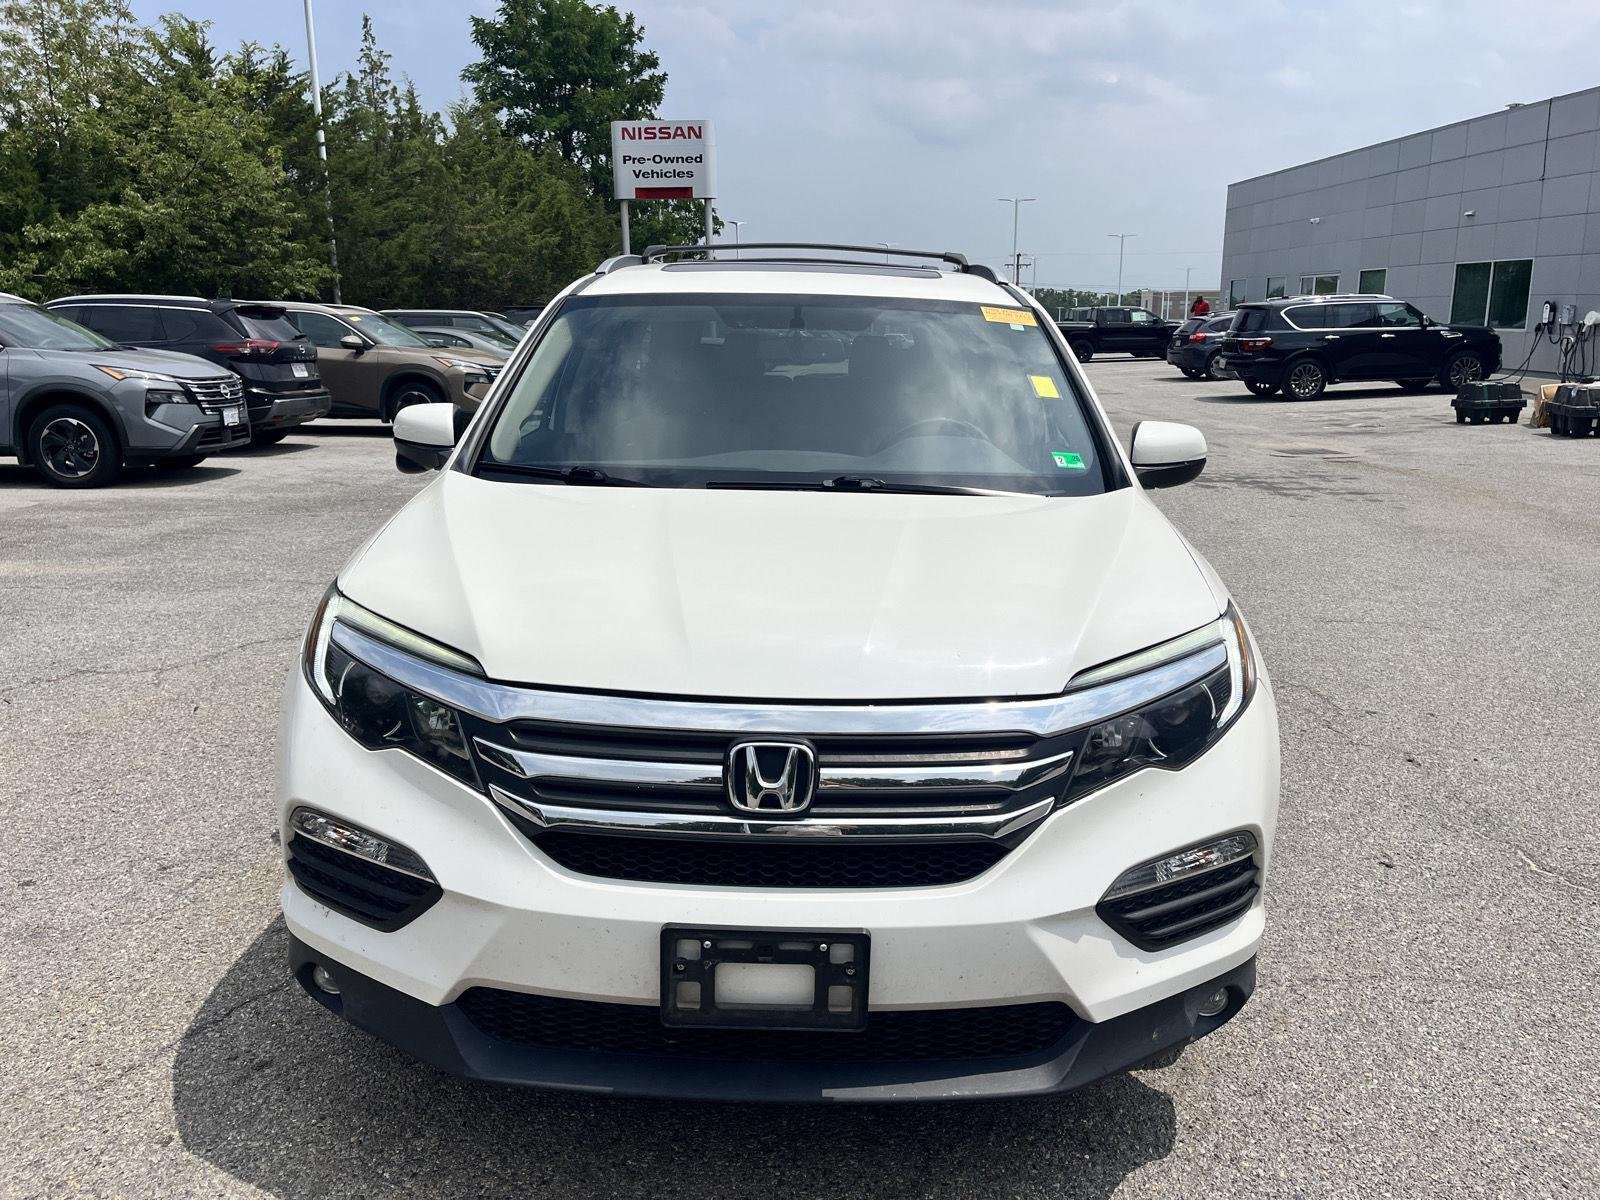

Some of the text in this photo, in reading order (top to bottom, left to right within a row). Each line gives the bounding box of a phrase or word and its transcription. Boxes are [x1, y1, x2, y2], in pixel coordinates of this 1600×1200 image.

[621, 126, 702, 140] NISSAN
[622, 154, 703, 164] Pre-Owned
[632, 169, 694, 179] Vehicles
